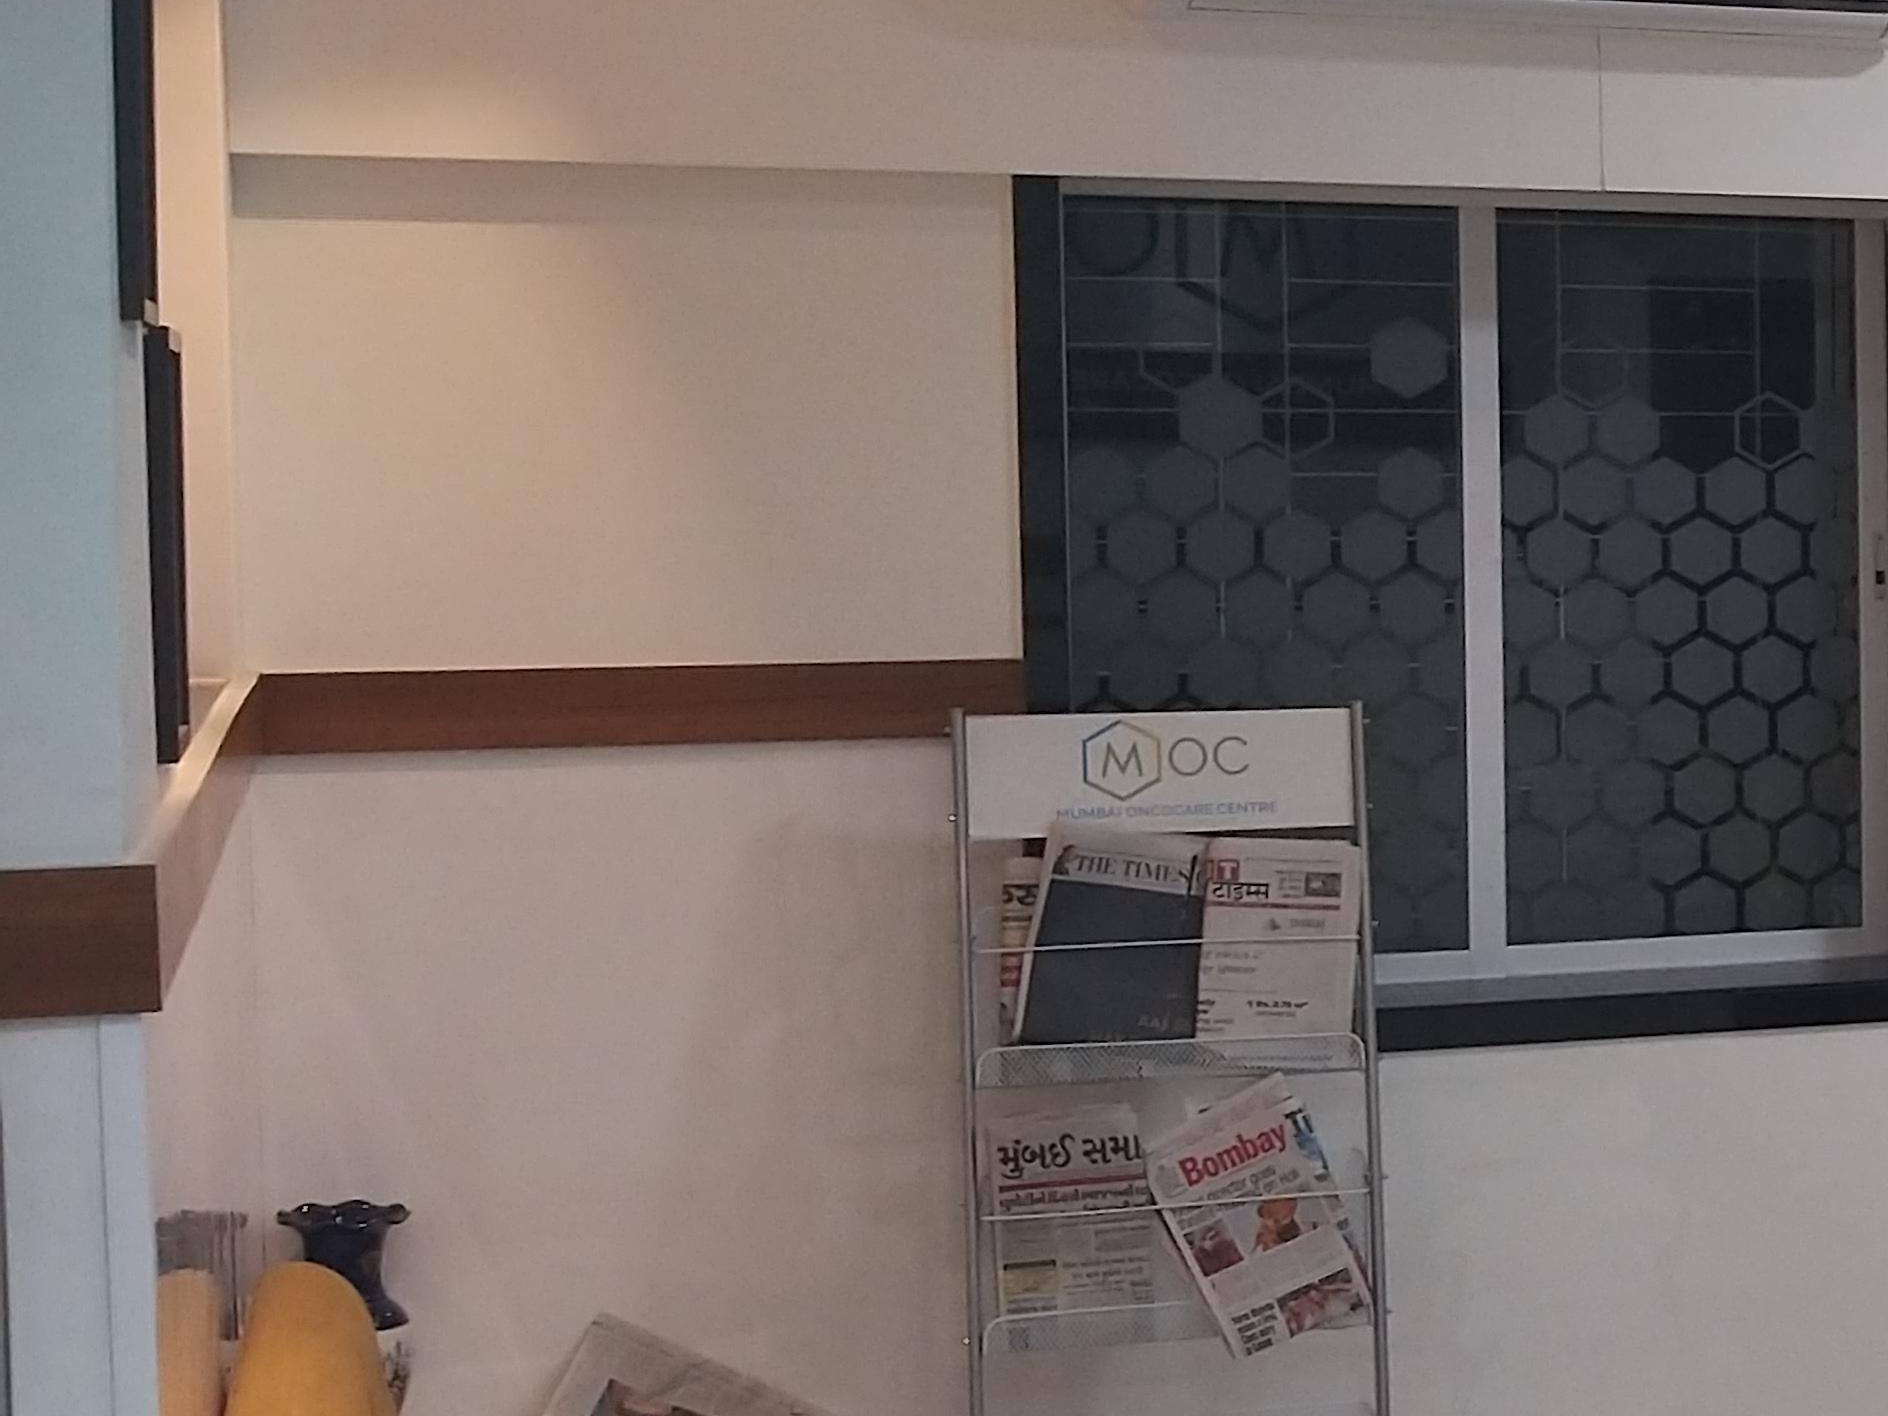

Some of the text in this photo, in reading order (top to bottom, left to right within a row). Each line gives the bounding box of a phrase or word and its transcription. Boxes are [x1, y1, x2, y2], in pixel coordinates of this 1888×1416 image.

[1101, 735, 1250, 778] MOC
[1056, 806, 1122, 821] MUMBAI
[1215, 800, 1278, 815] CENTRE
[1077, 854, 1116, 875] THE
[997, 1133, 1076, 1180] મુંબઈ
[1178, 1124, 1287, 1187] Bombay
